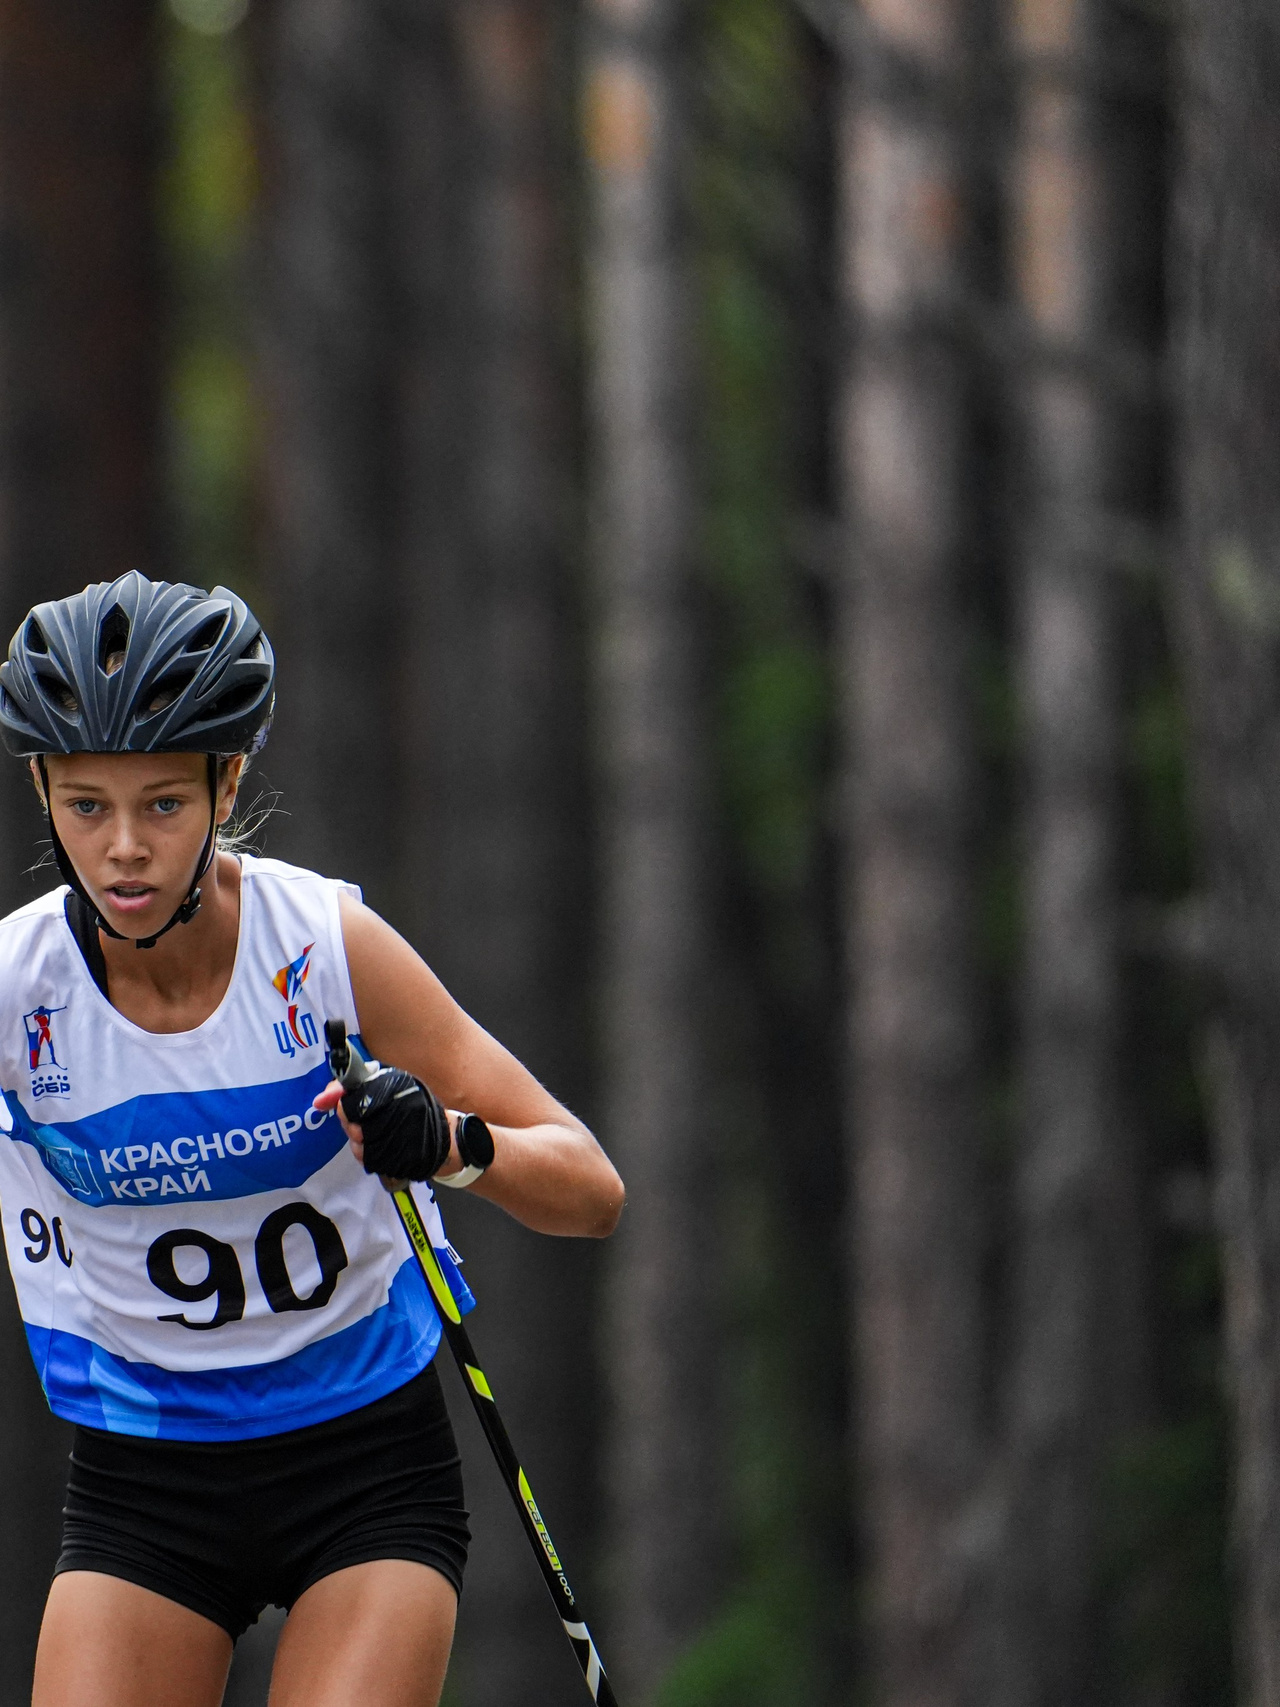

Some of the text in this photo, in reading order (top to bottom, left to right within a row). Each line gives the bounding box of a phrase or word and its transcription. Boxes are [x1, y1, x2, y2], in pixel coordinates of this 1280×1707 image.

[32, 1082, 71, 1097] СБР
[99, 1106, 335, 1174] КРАСНОЯРС
[109, 1165, 212, 1198] КРАЙ
[146, 1202, 349, 1330] 90
